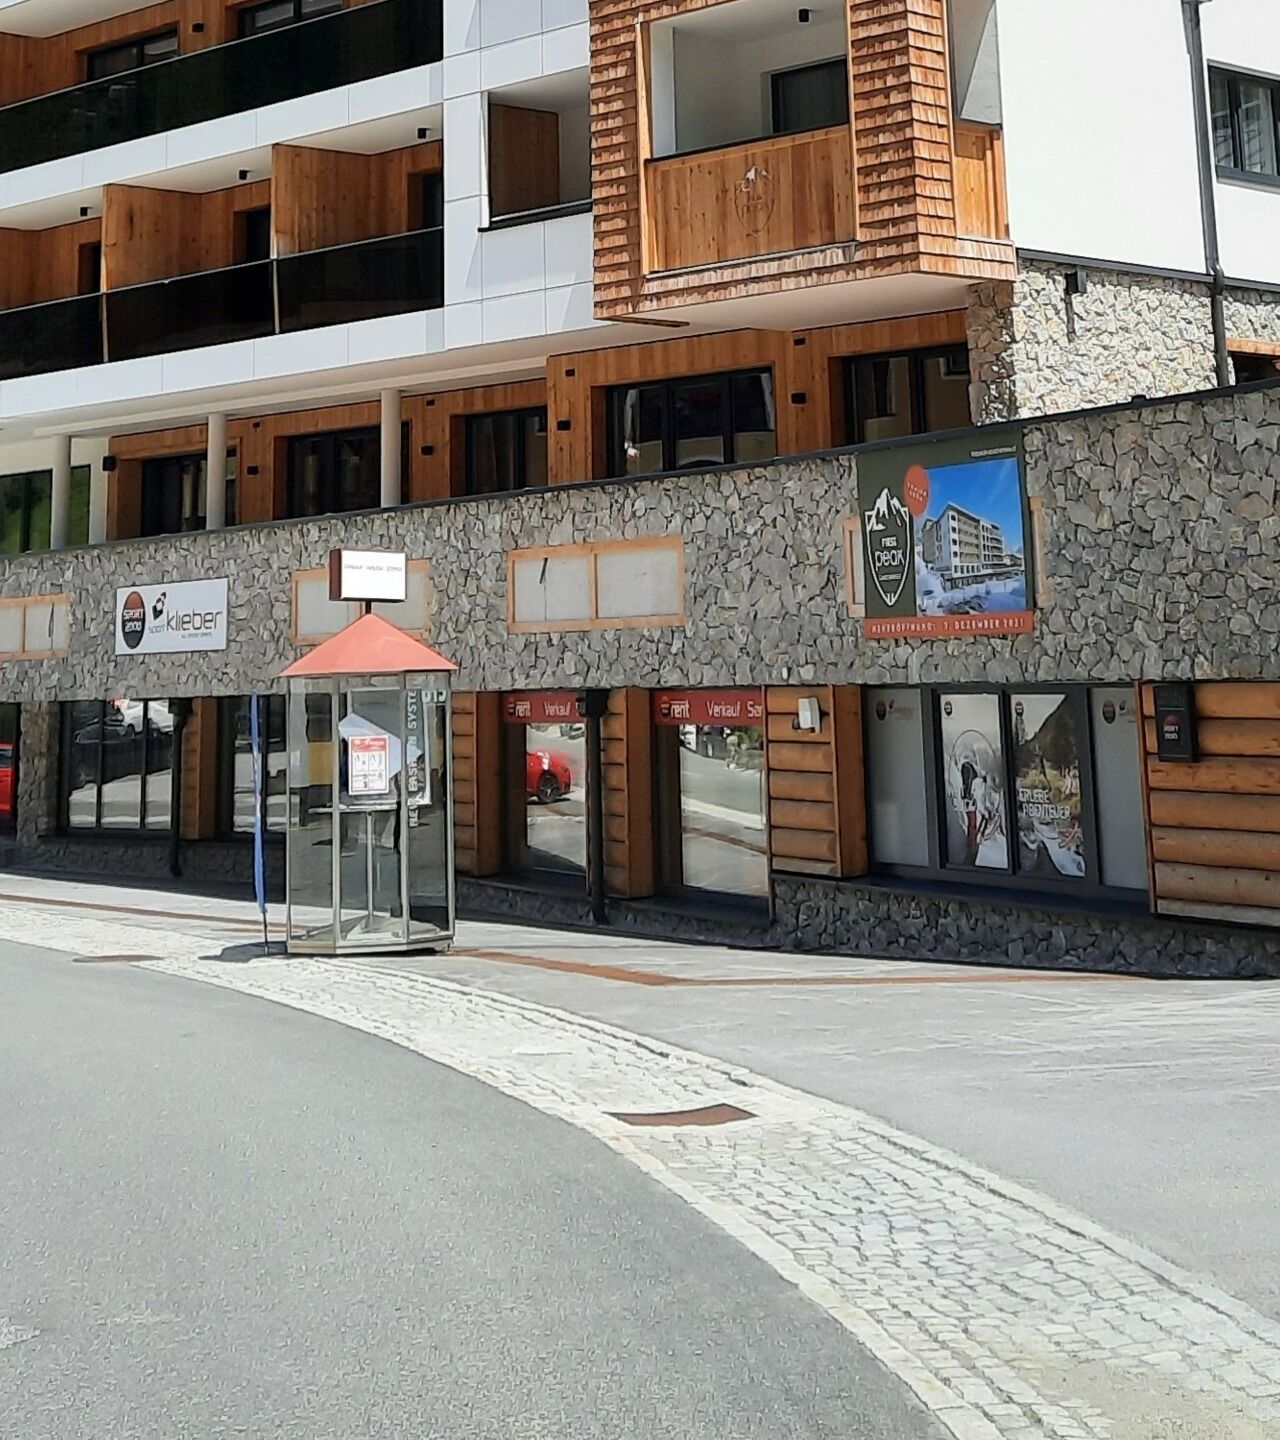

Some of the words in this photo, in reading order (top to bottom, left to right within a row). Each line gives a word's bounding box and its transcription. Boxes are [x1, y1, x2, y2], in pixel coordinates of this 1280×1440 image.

[875, 549, 905, 572] peak
[166, 608, 223, 632] klieber
[670, 701, 690, 718] rent
[707, 700, 742, 717] Verkauf
